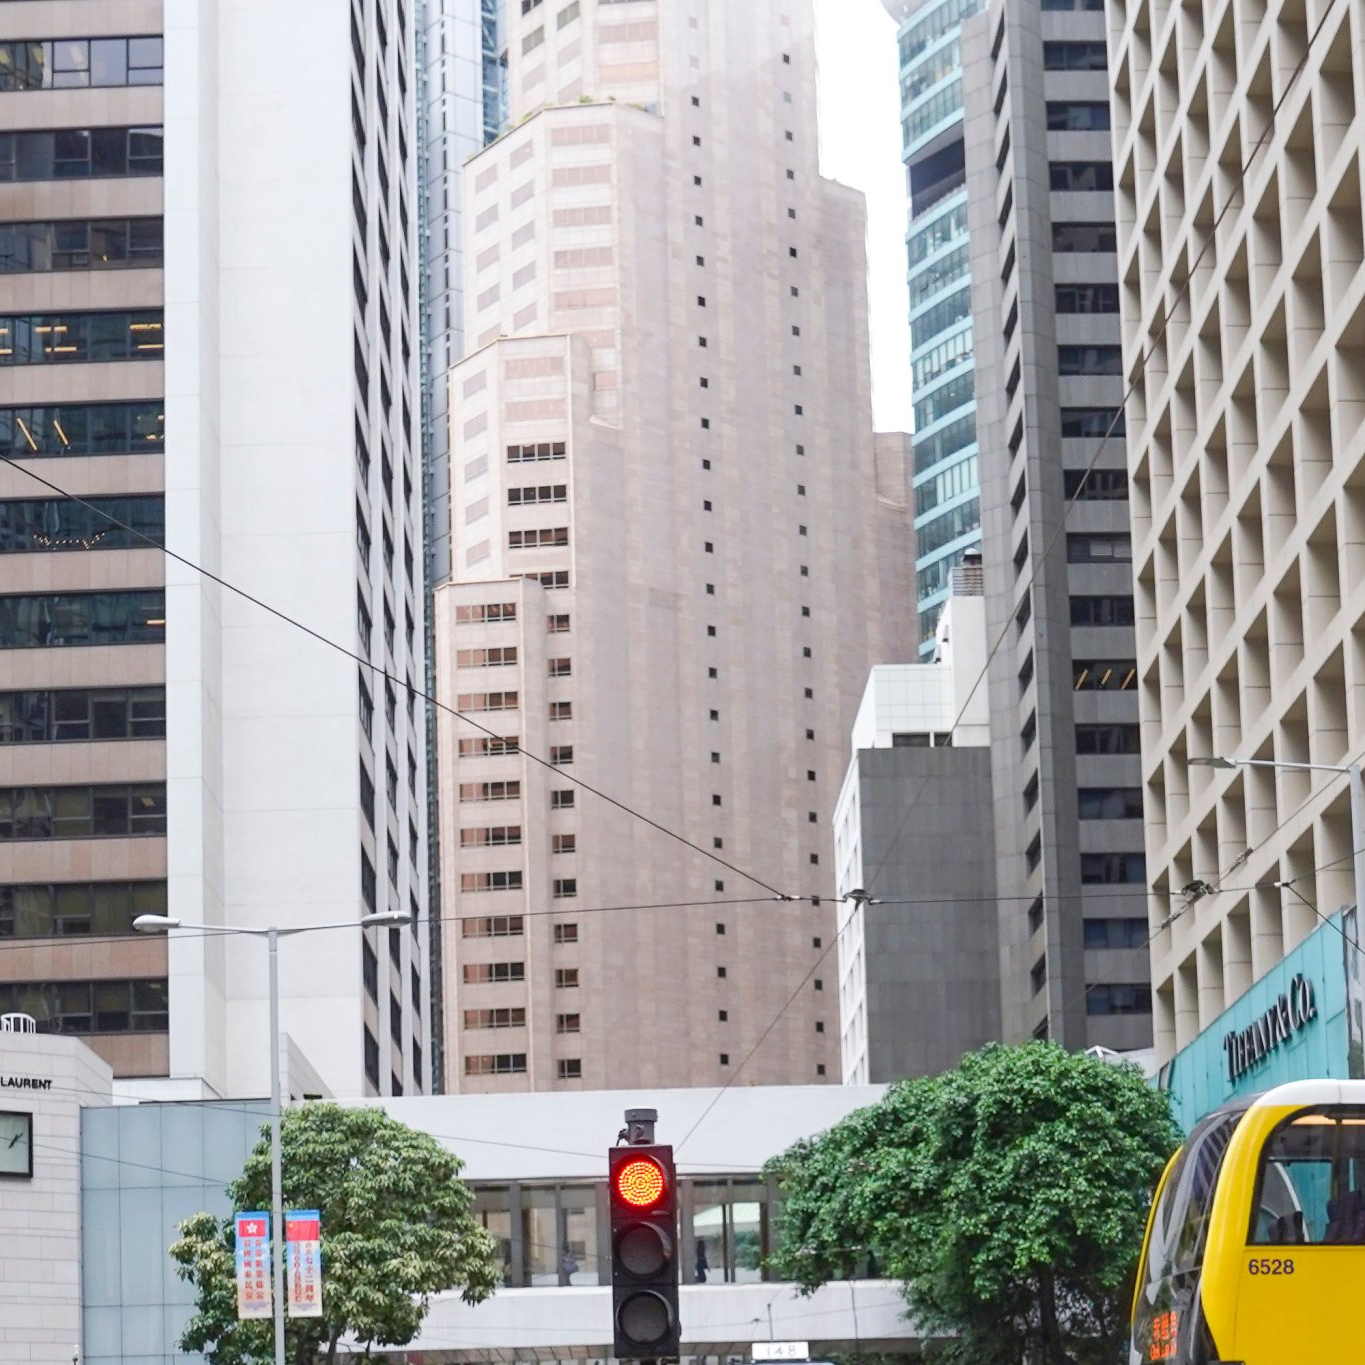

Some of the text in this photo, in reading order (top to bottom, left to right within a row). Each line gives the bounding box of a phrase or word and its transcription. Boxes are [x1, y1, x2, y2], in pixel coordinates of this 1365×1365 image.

[0, 1077, 52, 1090] LAURENT
[1248, 1259, 1295, 1275] 6528
[767, 1345, 796, 1355] 148
